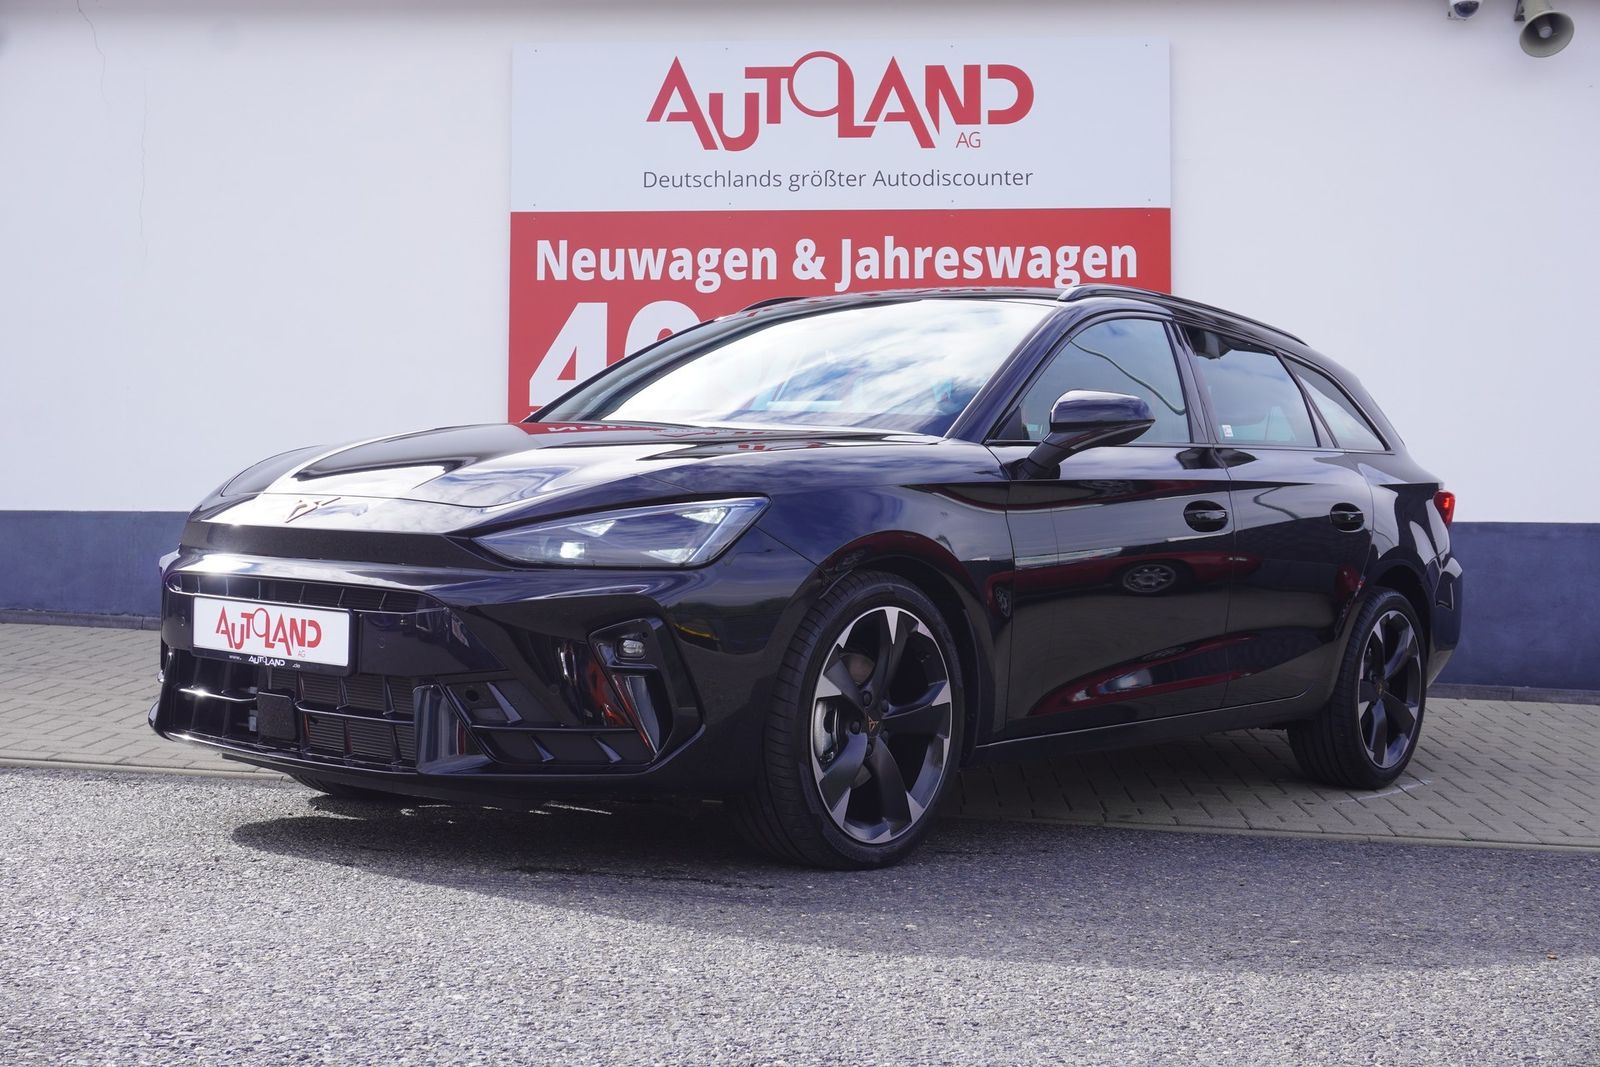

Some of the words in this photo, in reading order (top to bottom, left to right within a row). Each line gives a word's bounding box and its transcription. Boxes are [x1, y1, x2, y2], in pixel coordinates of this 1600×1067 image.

[646, 51, 1034, 152] AUTOLAND
[956, 131, 981, 149] AG
[643, 170, 782, 189] Deutschlands
[788, 169, 867, 193] größter
[872, 168, 1034, 188] Autodiscounter
[536, 240, 777, 293] Neuwagen
[792, 239, 826, 281] &
[834, 236, 1138, 290] Jahreswagen
[215, 605, 322, 656] AUTOLAND
